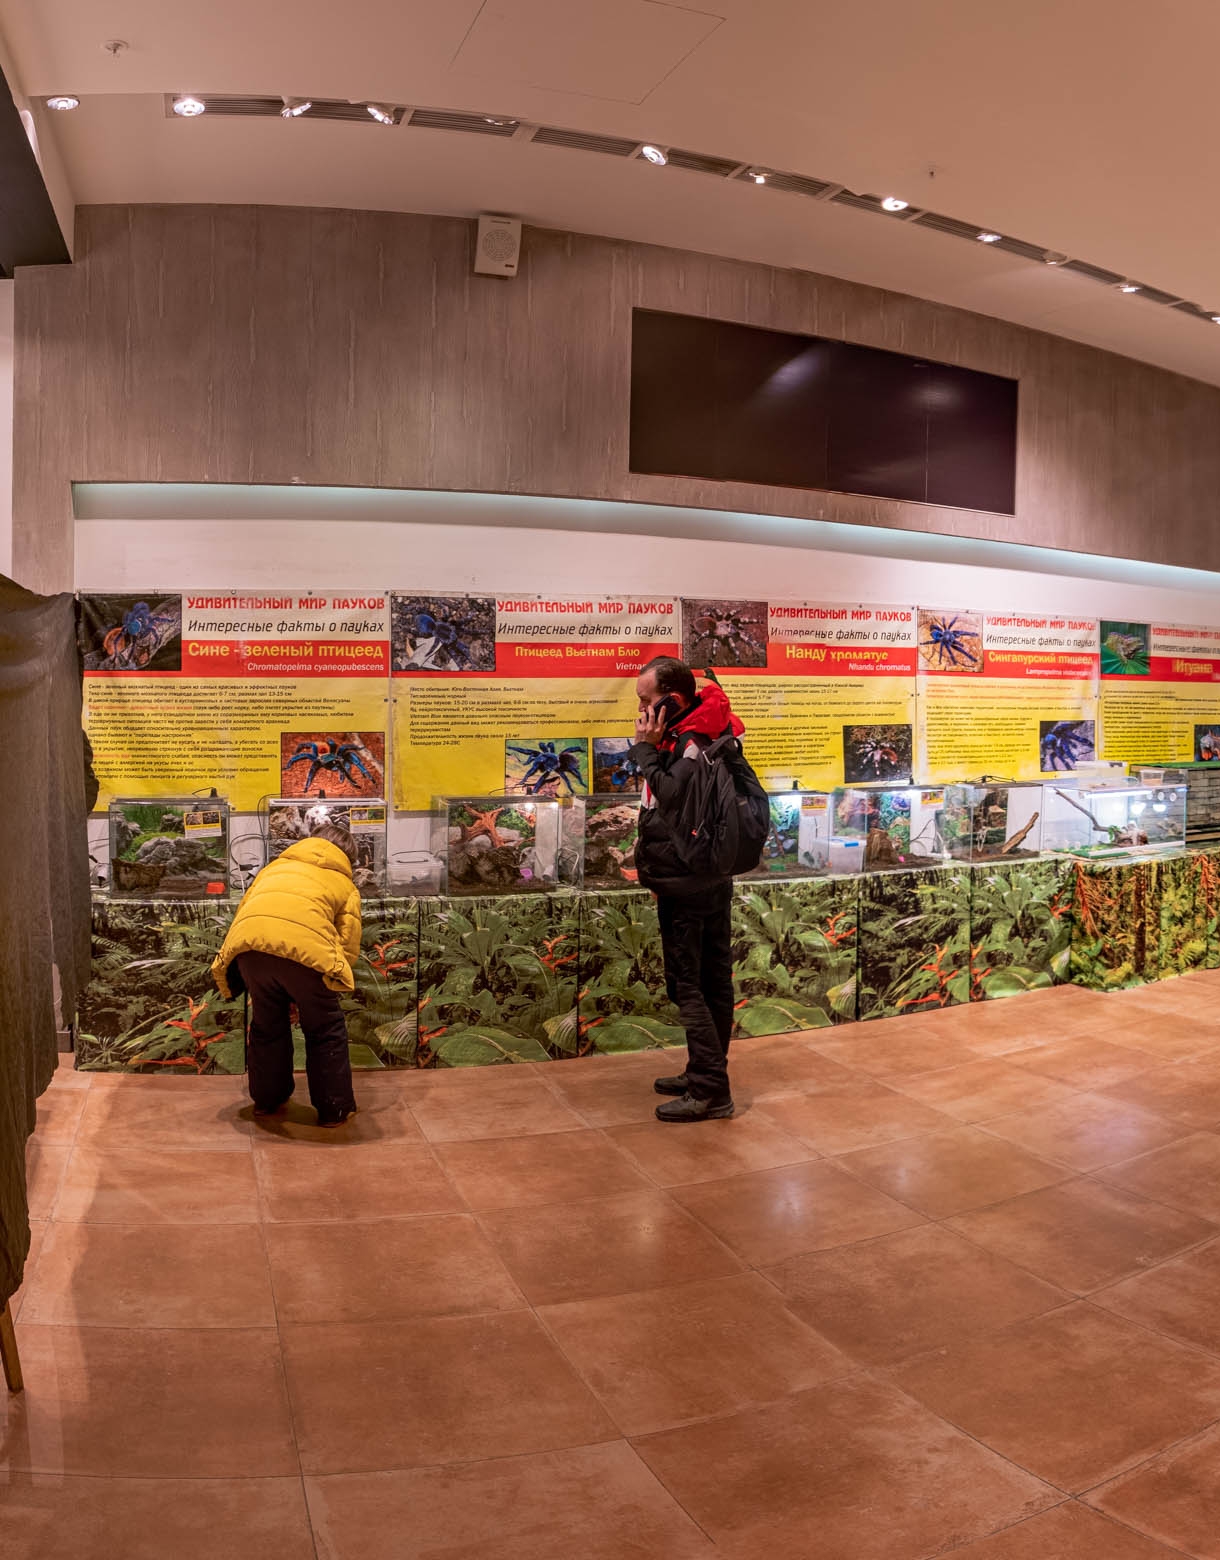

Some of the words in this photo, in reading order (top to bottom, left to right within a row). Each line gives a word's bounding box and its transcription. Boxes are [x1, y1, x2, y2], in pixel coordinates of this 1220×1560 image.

[187, 597, 293, 609] УДИВИТЕЛЬНЫЙ
[298, 598, 327, 609] МИР
[332, 598, 385, 610] ПАУКОВ
[498, 600, 593, 613] УДИВИТЕЛЬНЫЙ
[598, 602, 624, 613] МИР
[628, 602, 674, 614] ПАУКОВ
[770, 607, 847, 620] УДИВИТЕЛЬНЫЙ
[851, 610, 872, 620] МИР
[875, 611, 912, 622] ПАУКОВ
[188, 620, 273, 635] Интересные
[276, 620, 325, 635] факты
[329, 622, 337, 632] о
[340, 620, 384, 635] пауках
[986, 615, 1047, 628] УДИВИТЕЛЬНЫЙ
[1050, 620, 1065, 630] МИР
[498, 622, 576, 637] Интересные
[578, 622, 621, 637] факты
[624, 626, 631, 635] о
[634, 624, 673, 638] пауках
[836, 629, 870, 641] факты
[872, 631, 879, 639] о
[881, 631, 911, 642] пауках
[986, 634, 1036, 646] Интересные
[1038, 637, 1064, 647] факты
[188, 642, 230, 657] Сине
[244, 641, 313, 658] зеленый
[318, 646, 384, 659] птицеед
[515, 646, 563, 658] Птицеед
[565, 646, 615, 658] Вьетнам
[618, 646, 640, 657] Блю
[786, 645, 827, 662] Нанду
[988, 651, 1056, 665] Сингапурский
[247, 662, 312, 672] Chromatopelma
[313, 662, 385, 673] cyaneopubescens
